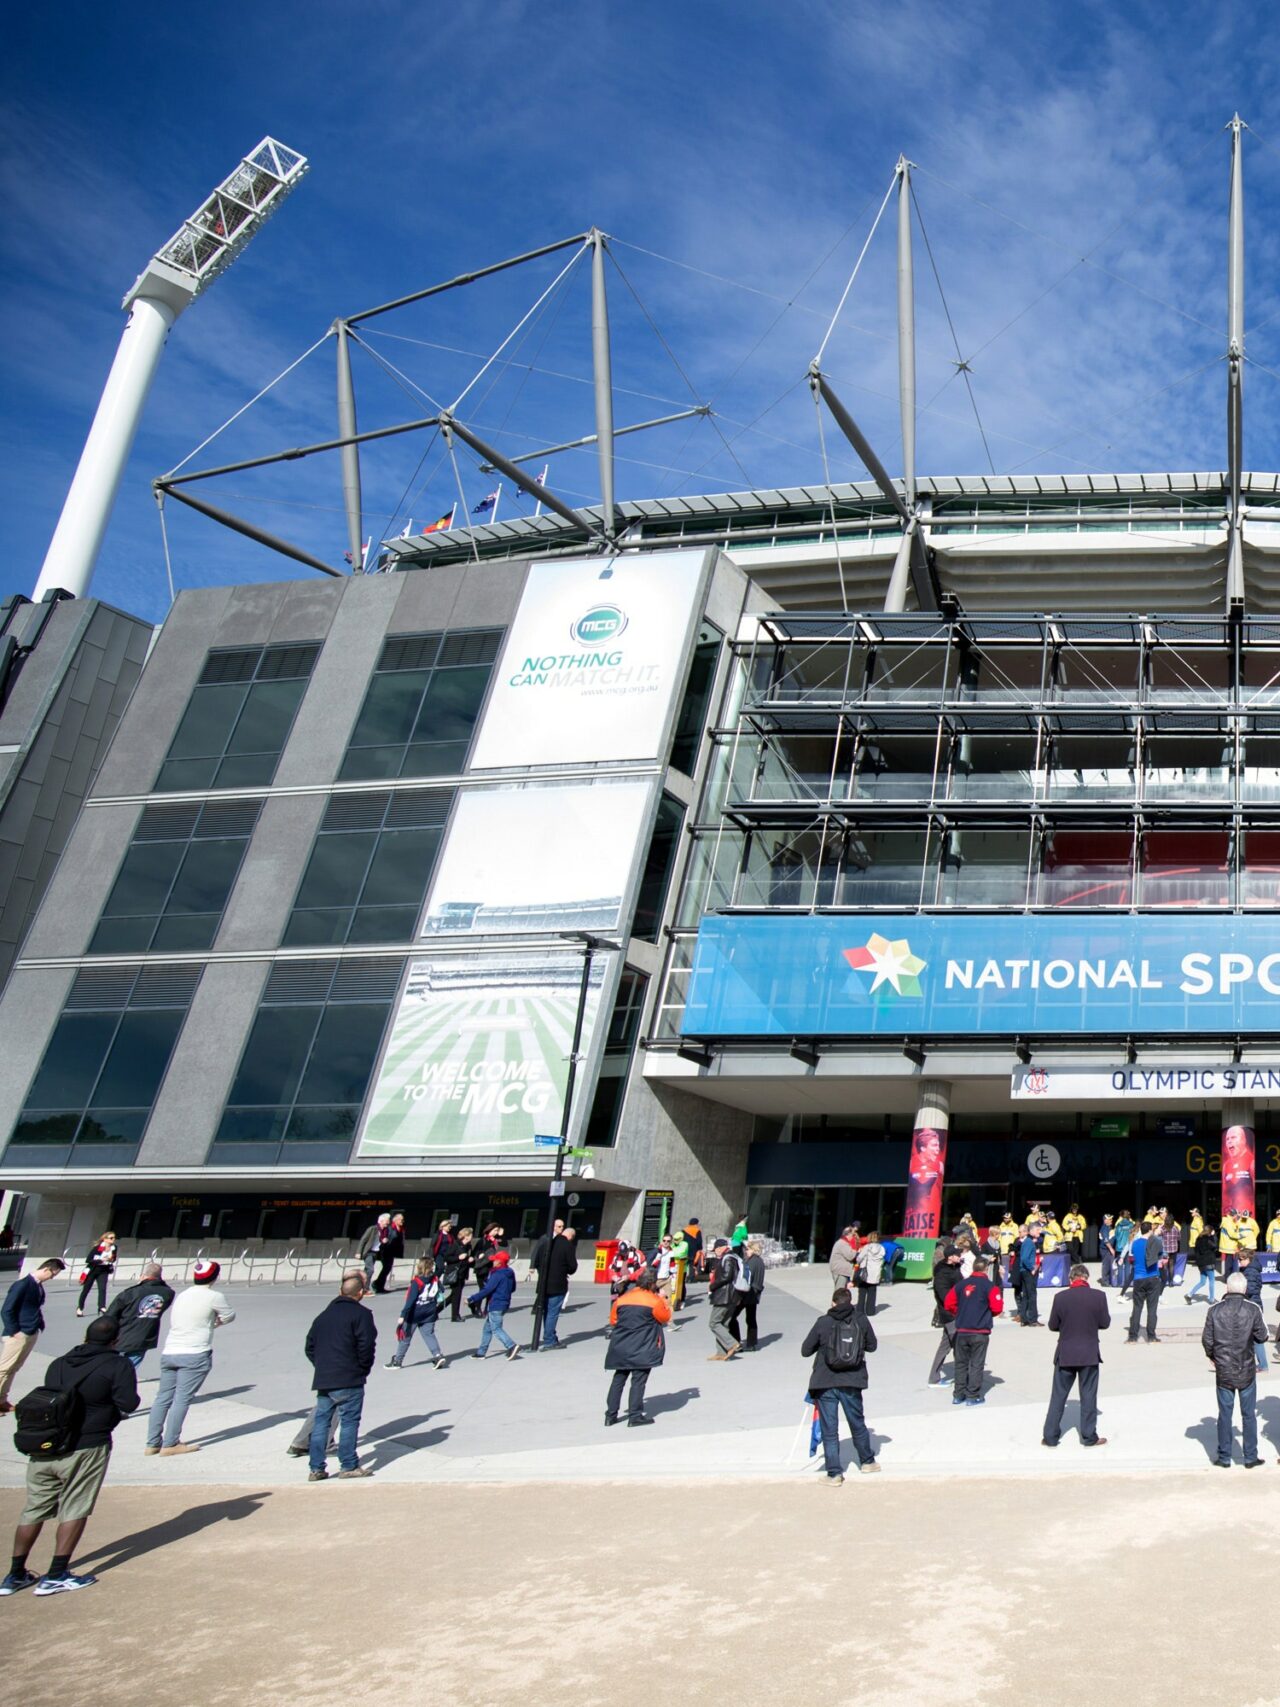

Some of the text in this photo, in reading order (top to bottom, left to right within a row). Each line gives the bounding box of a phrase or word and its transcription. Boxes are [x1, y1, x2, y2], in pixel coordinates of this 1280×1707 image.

[521, 651, 623, 672] NOTHING
[509, 664, 661, 688] CAN MATCH IT.
[580, 684, 659, 697] www.mcg.org.au
[944, 959, 1163, 989] NATIONAL
[421, 1060, 543, 1082] WELCOME
[1112, 1069, 1215, 1091] OLYMPIC
[403, 1082, 550, 1114] TO THE MCG
[1186, 1144, 1280, 1173] Ga 3
[171, 1196, 201, 1206] Tickets
[488, 1195, 519, 1205] Tickets
[908, 1252, 925, 1261] FREE
